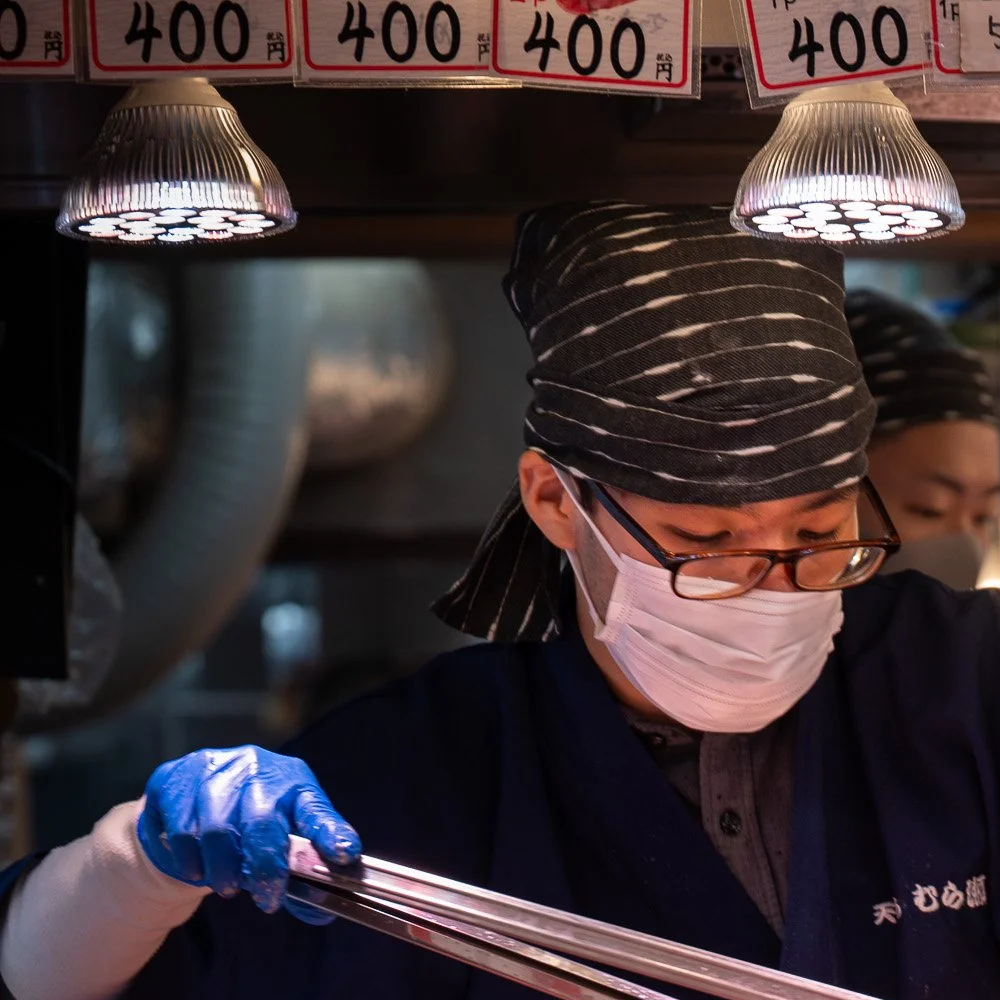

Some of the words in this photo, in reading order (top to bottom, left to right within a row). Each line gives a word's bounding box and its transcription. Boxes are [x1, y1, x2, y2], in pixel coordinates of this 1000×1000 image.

[126, 1, 249, 62] 400
[338, 1, 460, 62] 400
[524, 10, 645, 78] 400
[788, 6, 908, 77] 400
